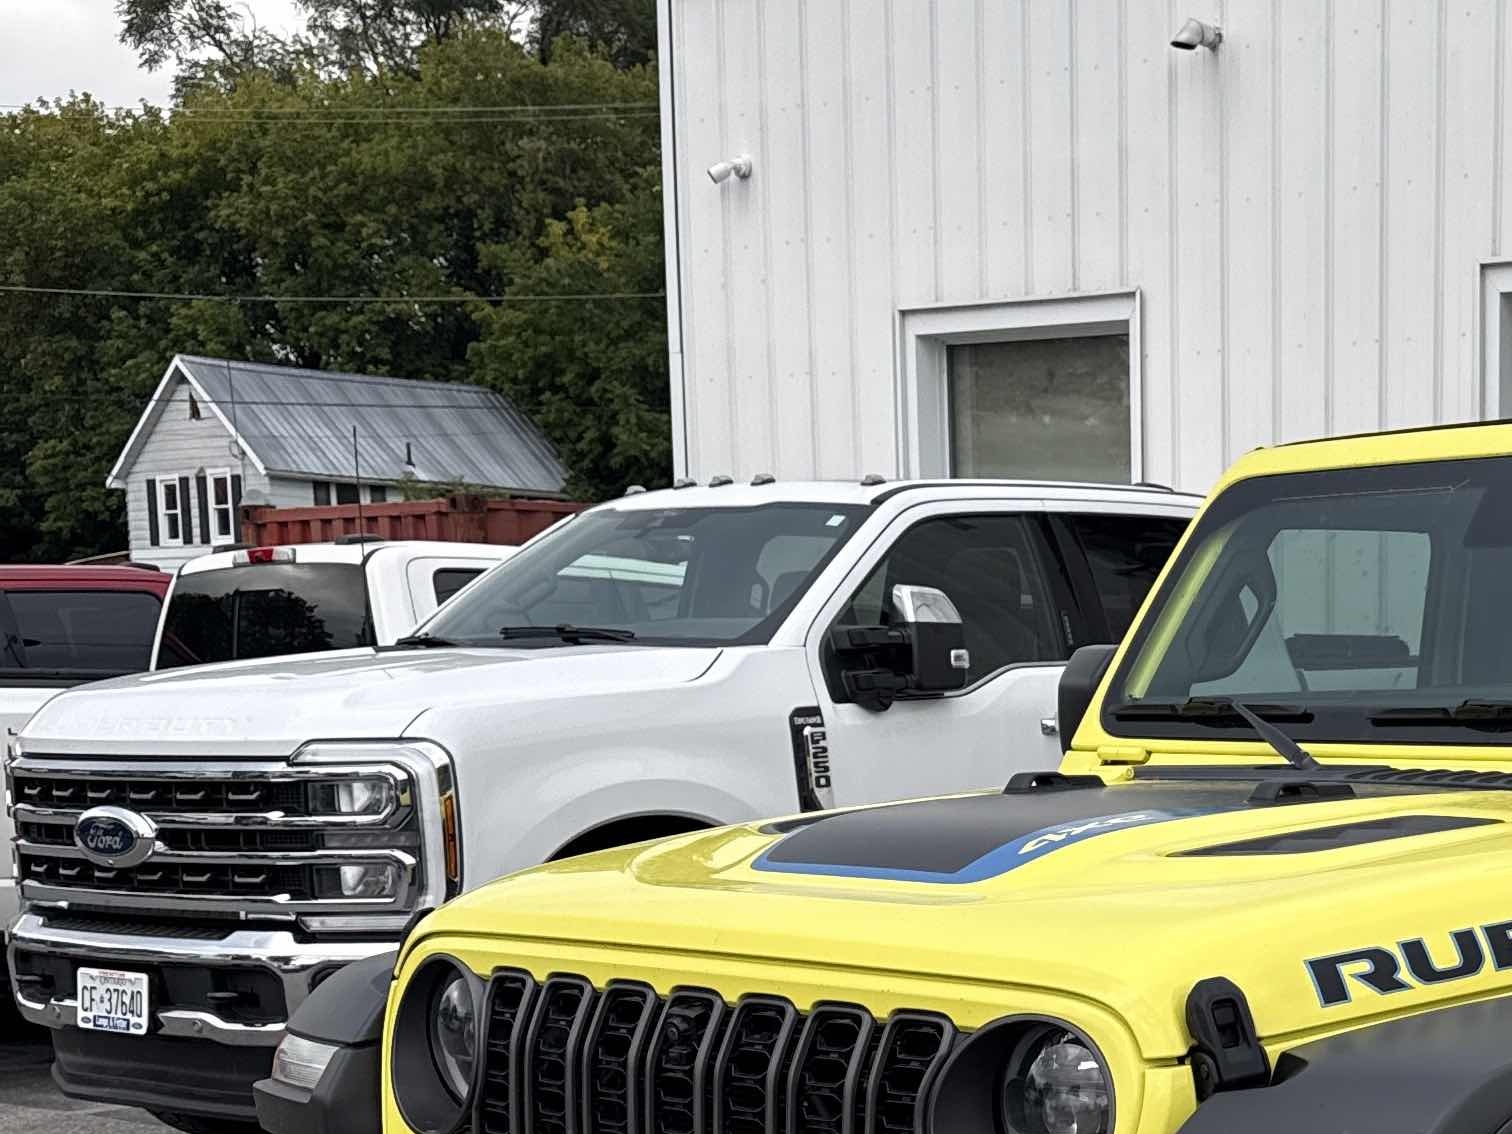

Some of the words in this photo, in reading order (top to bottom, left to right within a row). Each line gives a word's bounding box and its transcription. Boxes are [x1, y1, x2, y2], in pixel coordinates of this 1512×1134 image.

[87, 823, 125, 849] Ford
[82, 985, 97, 1012] CF
[105, 988, 143, 1018] 37640
